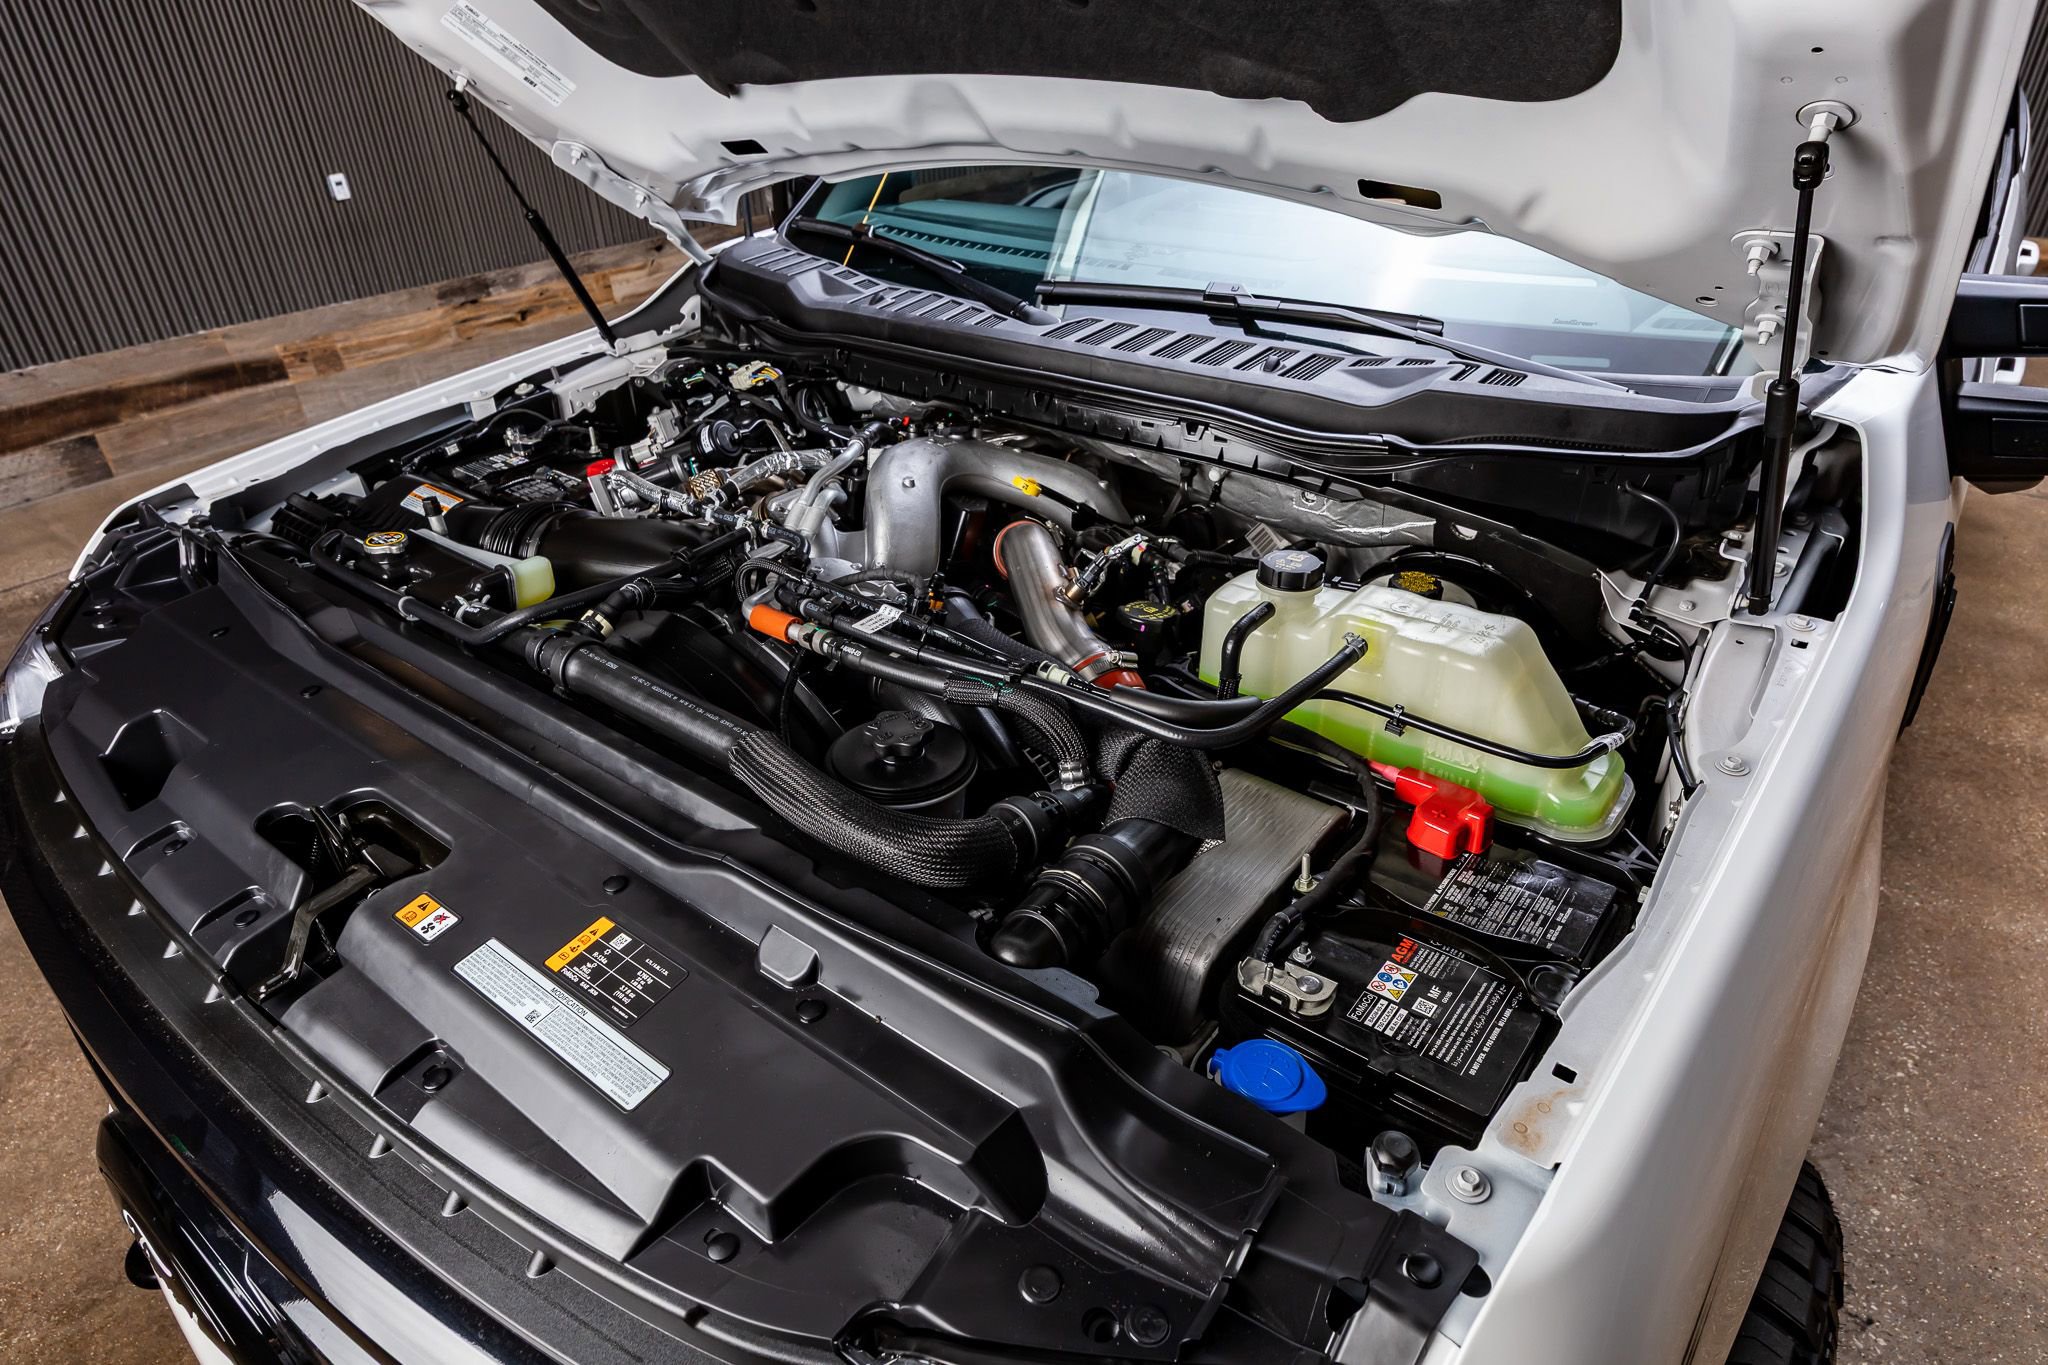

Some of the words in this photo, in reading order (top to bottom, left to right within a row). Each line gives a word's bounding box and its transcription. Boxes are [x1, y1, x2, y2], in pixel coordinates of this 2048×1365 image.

[592, 952, 609, 965] R-134a
[1390, 938, 1415, 963] AGM
[561, 968, 581, 983] FoMoCo
[550, 987, 589, 1017] MODIFICATION
[1427, 985, 1443, 1000] MF
[1351, 994, 1374, 1020] FoMoCo
